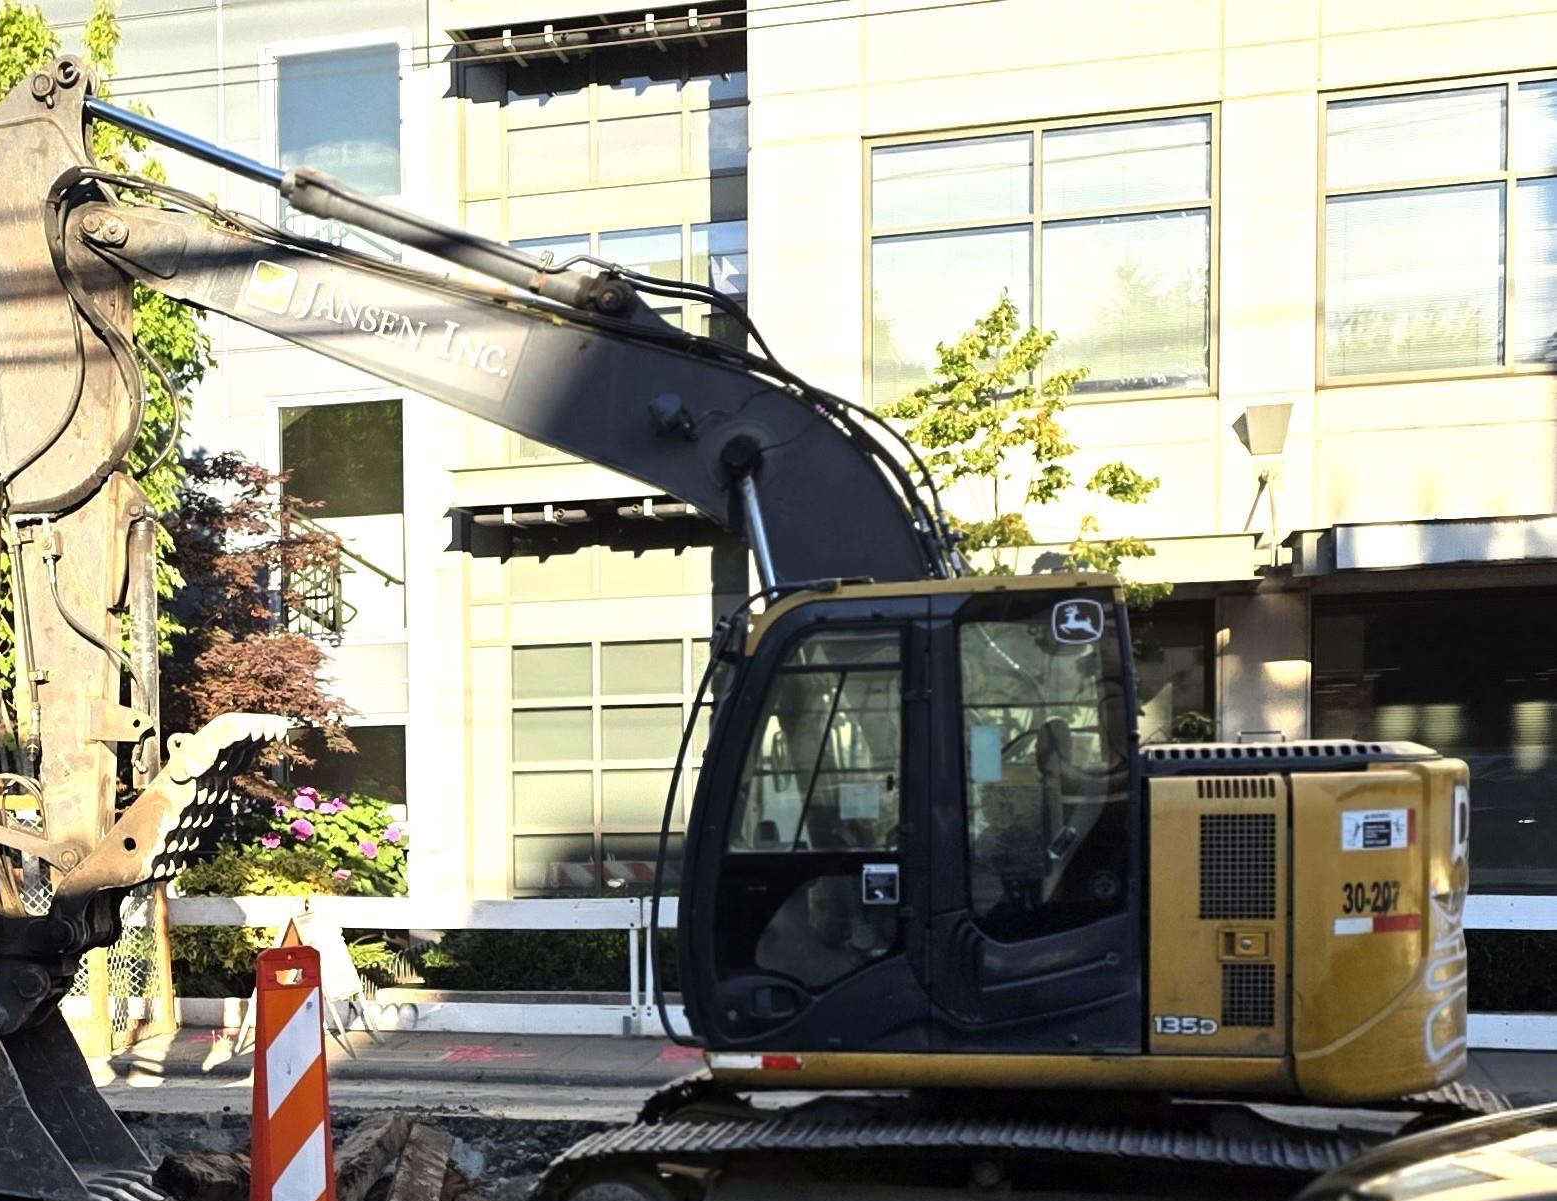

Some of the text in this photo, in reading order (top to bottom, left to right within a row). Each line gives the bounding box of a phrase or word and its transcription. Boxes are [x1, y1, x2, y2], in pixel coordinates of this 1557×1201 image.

[295, 278, 508, 377] JANSEN INC.
[1154, 1015, 1218, 1035] 135D
